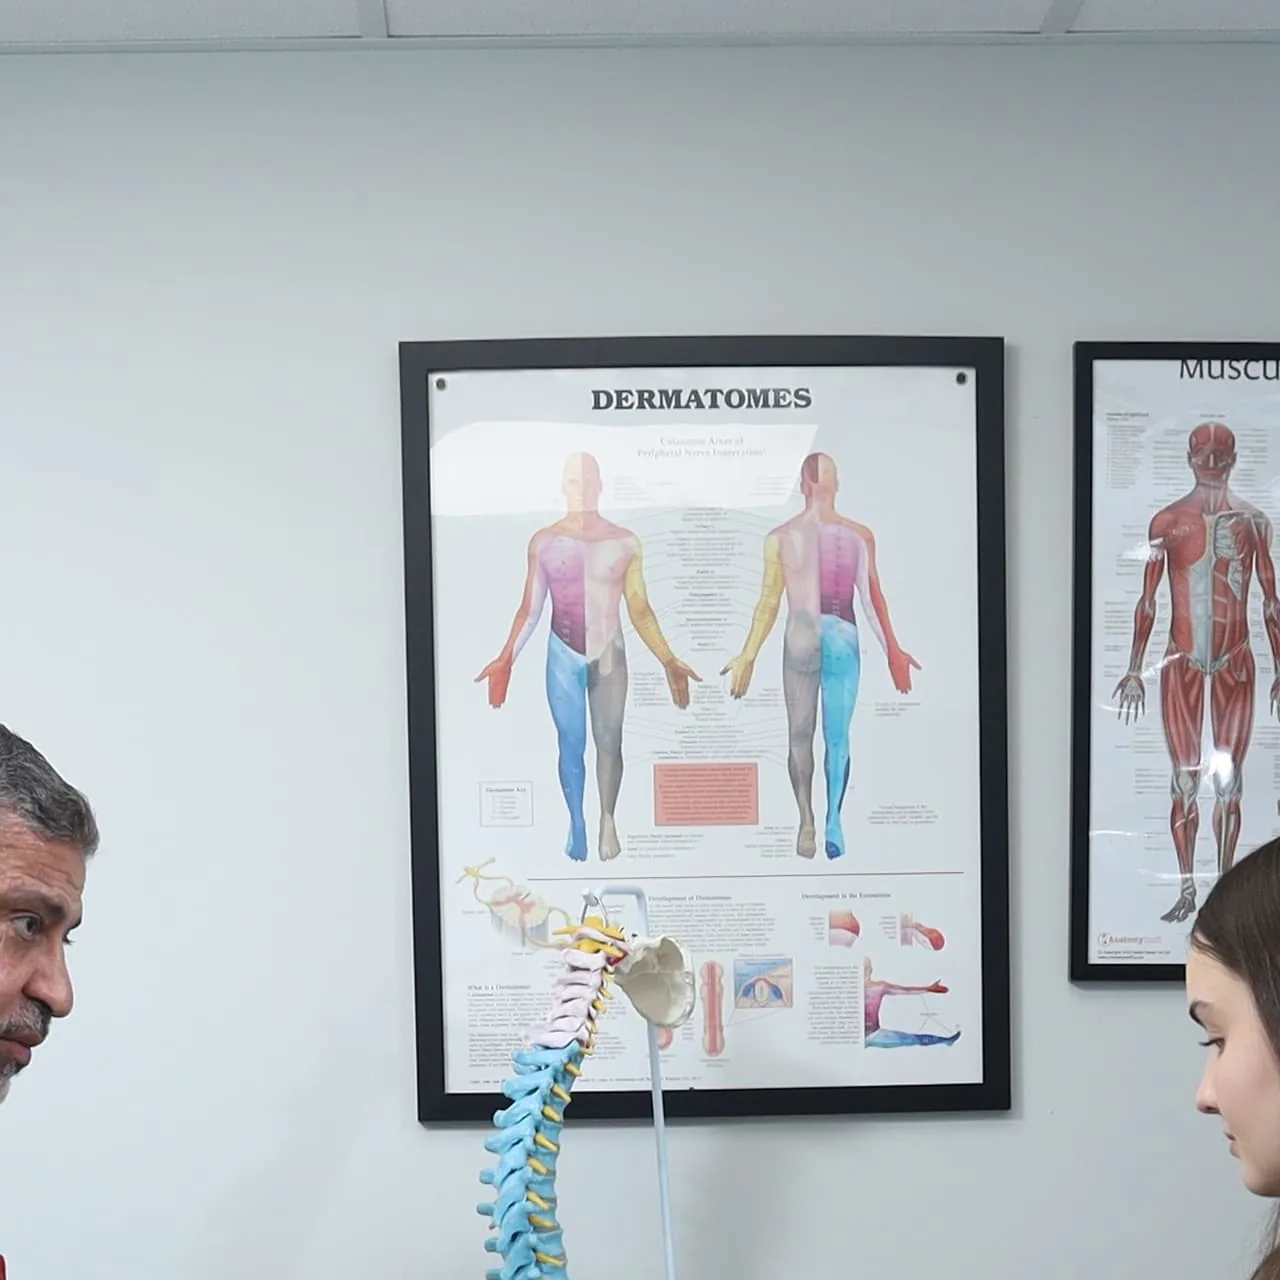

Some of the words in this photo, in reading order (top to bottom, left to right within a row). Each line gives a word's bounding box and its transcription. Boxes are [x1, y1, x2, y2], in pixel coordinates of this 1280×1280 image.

[591, 388, 812, 410] DERMATOMES
[734, 436, 744, 446] of
[637, 448, 683, 459] Peripheral
